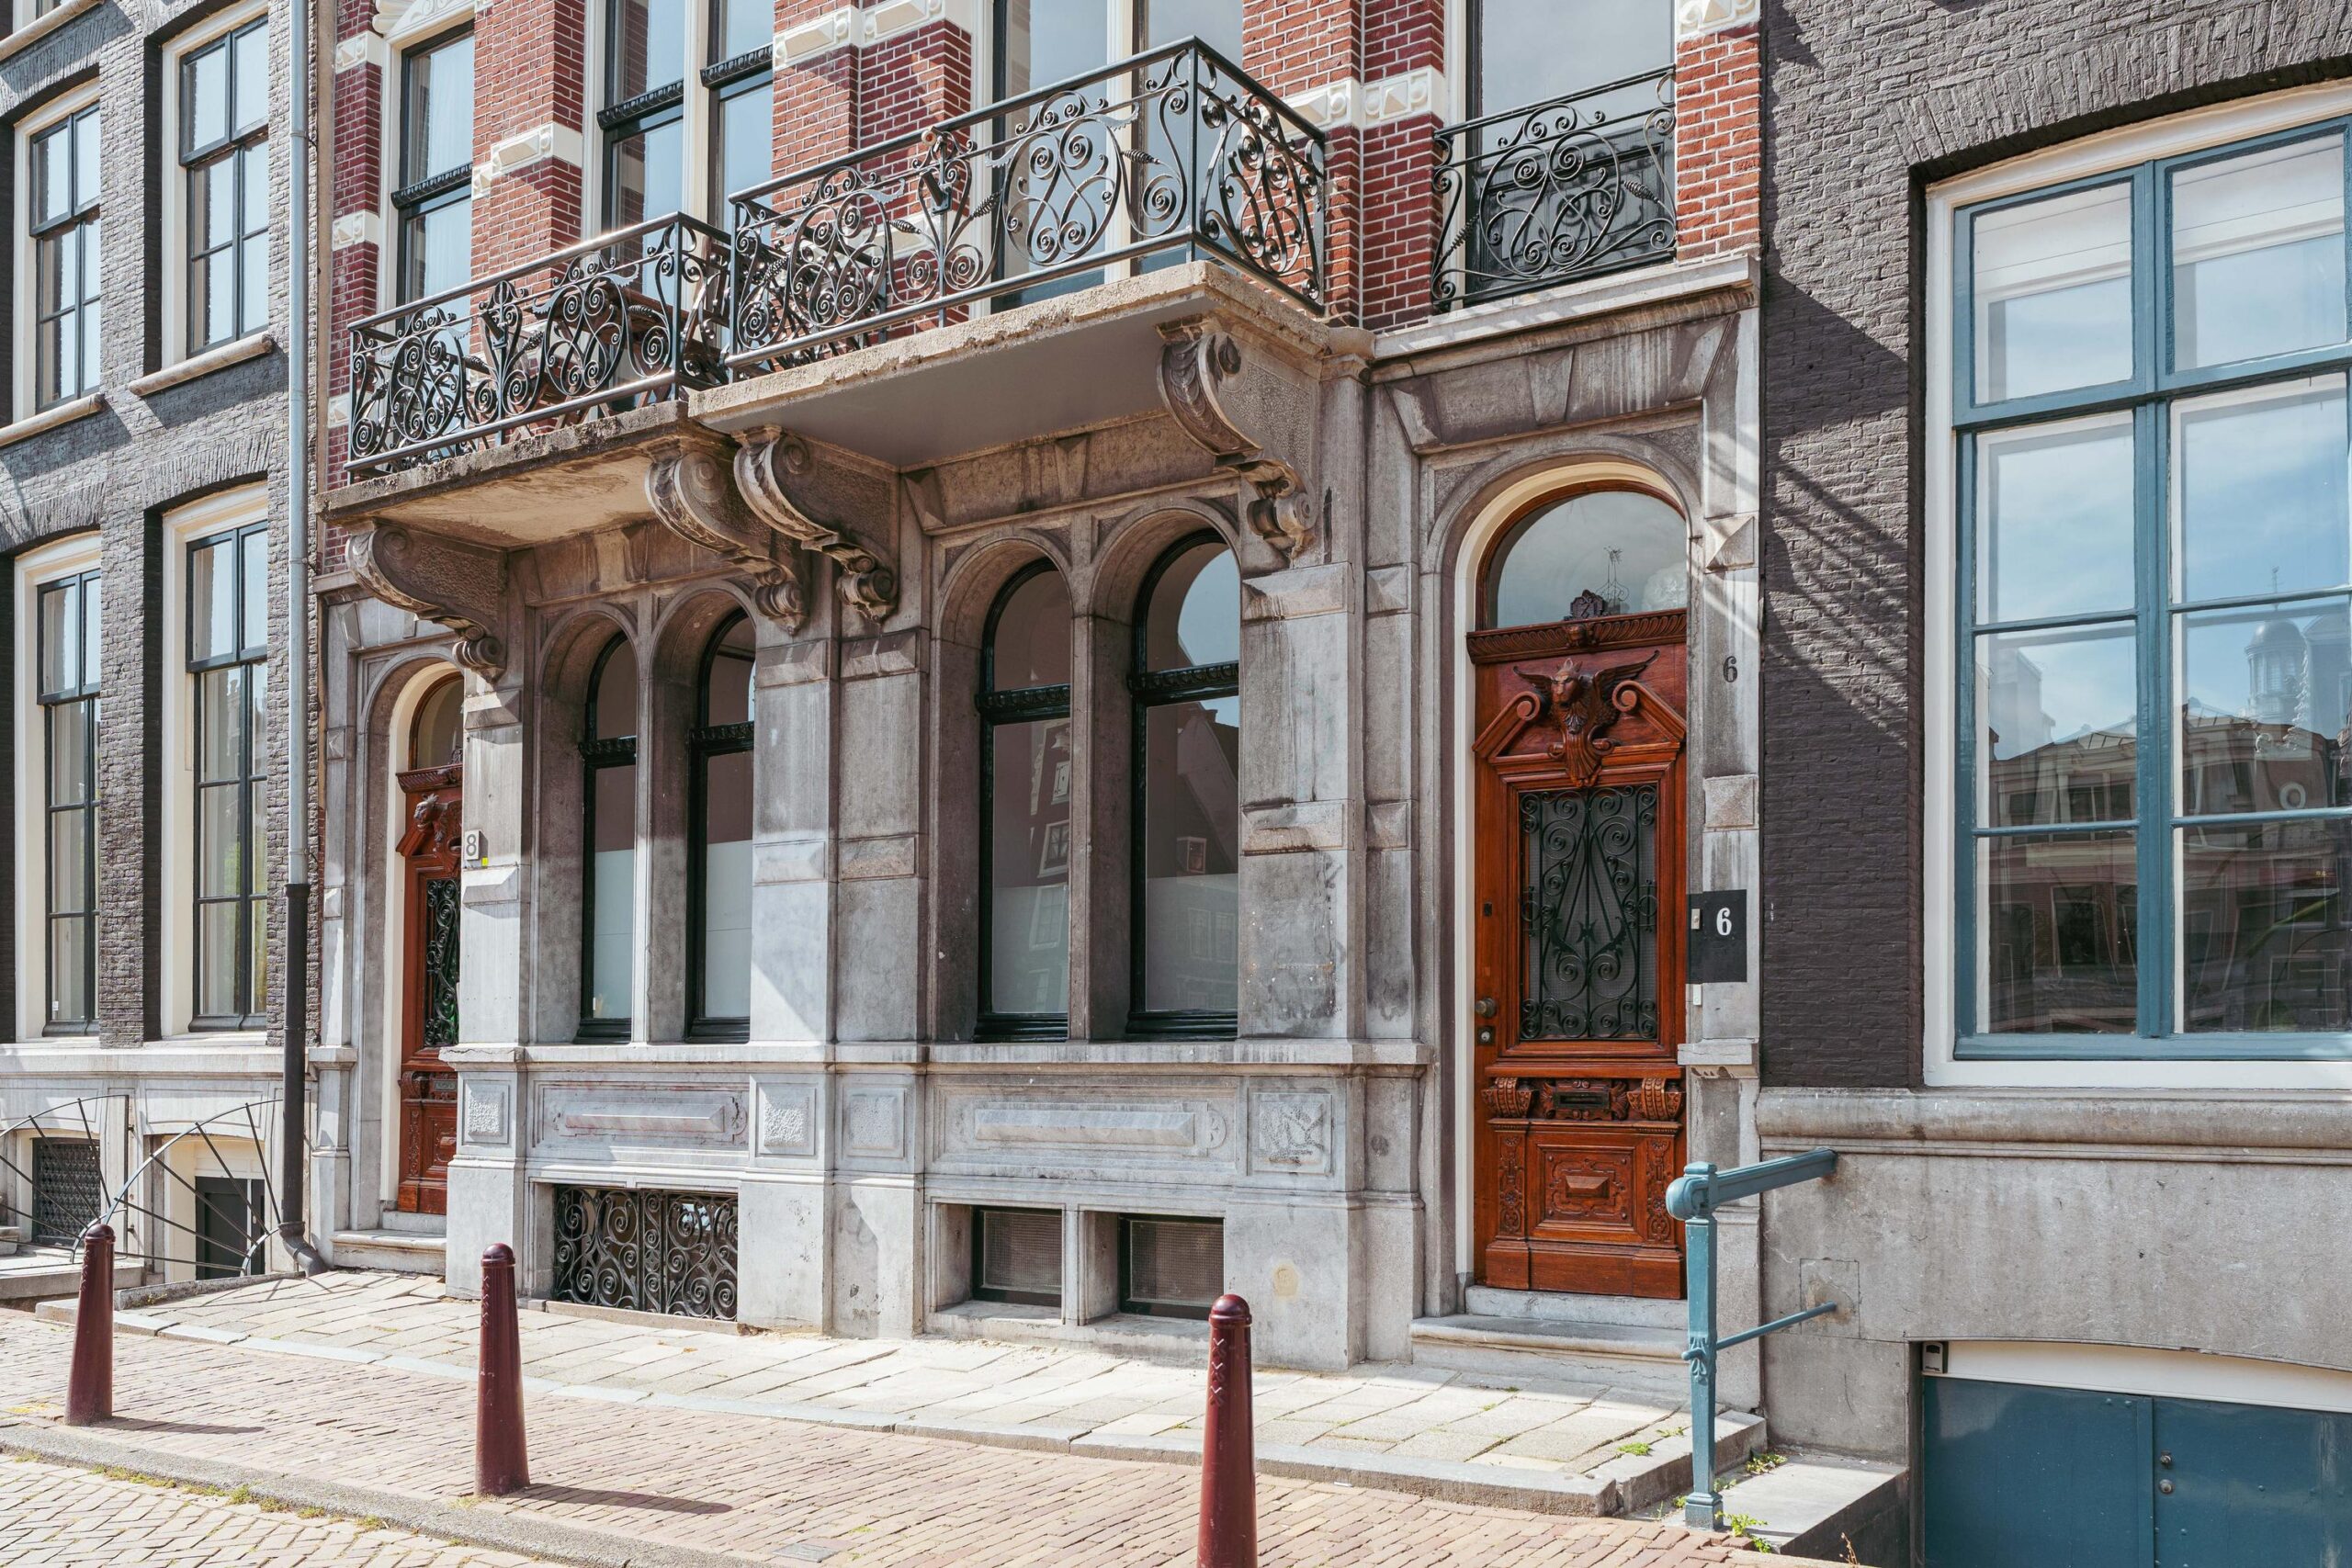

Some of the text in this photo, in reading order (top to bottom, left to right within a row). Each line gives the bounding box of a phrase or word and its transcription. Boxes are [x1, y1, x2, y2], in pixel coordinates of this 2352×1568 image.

[1723, 655, 1738, 682] 6
[466, 833, 477, 857] 8
[1716, 907, 1733, 936] 6
